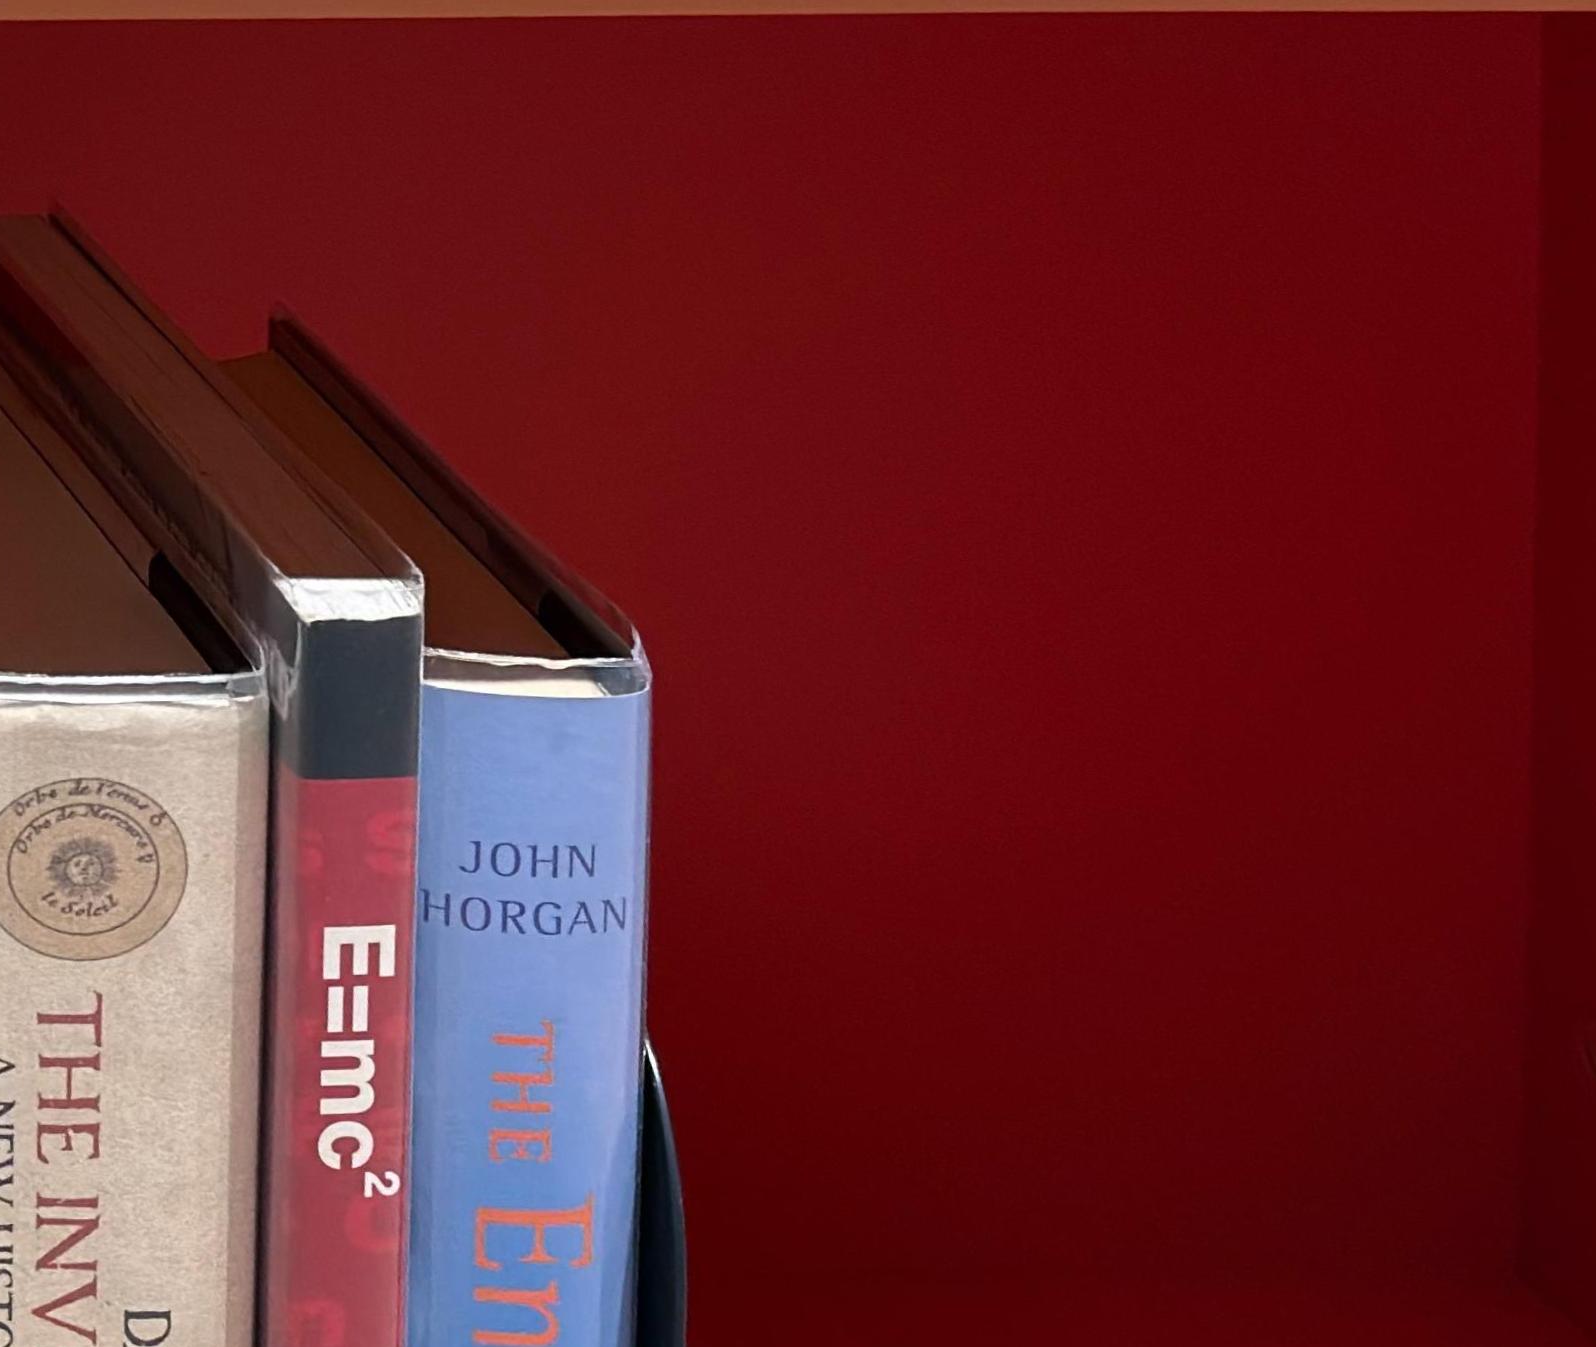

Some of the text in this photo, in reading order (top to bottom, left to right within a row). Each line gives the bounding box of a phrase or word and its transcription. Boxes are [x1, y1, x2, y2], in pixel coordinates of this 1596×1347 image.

[458, 840, 597, 880] JOHN
[418, 888, 628, 937] HORGAN
[37, 991, 102, 1165] THE
[488, 1019, 555, 1164] THE
